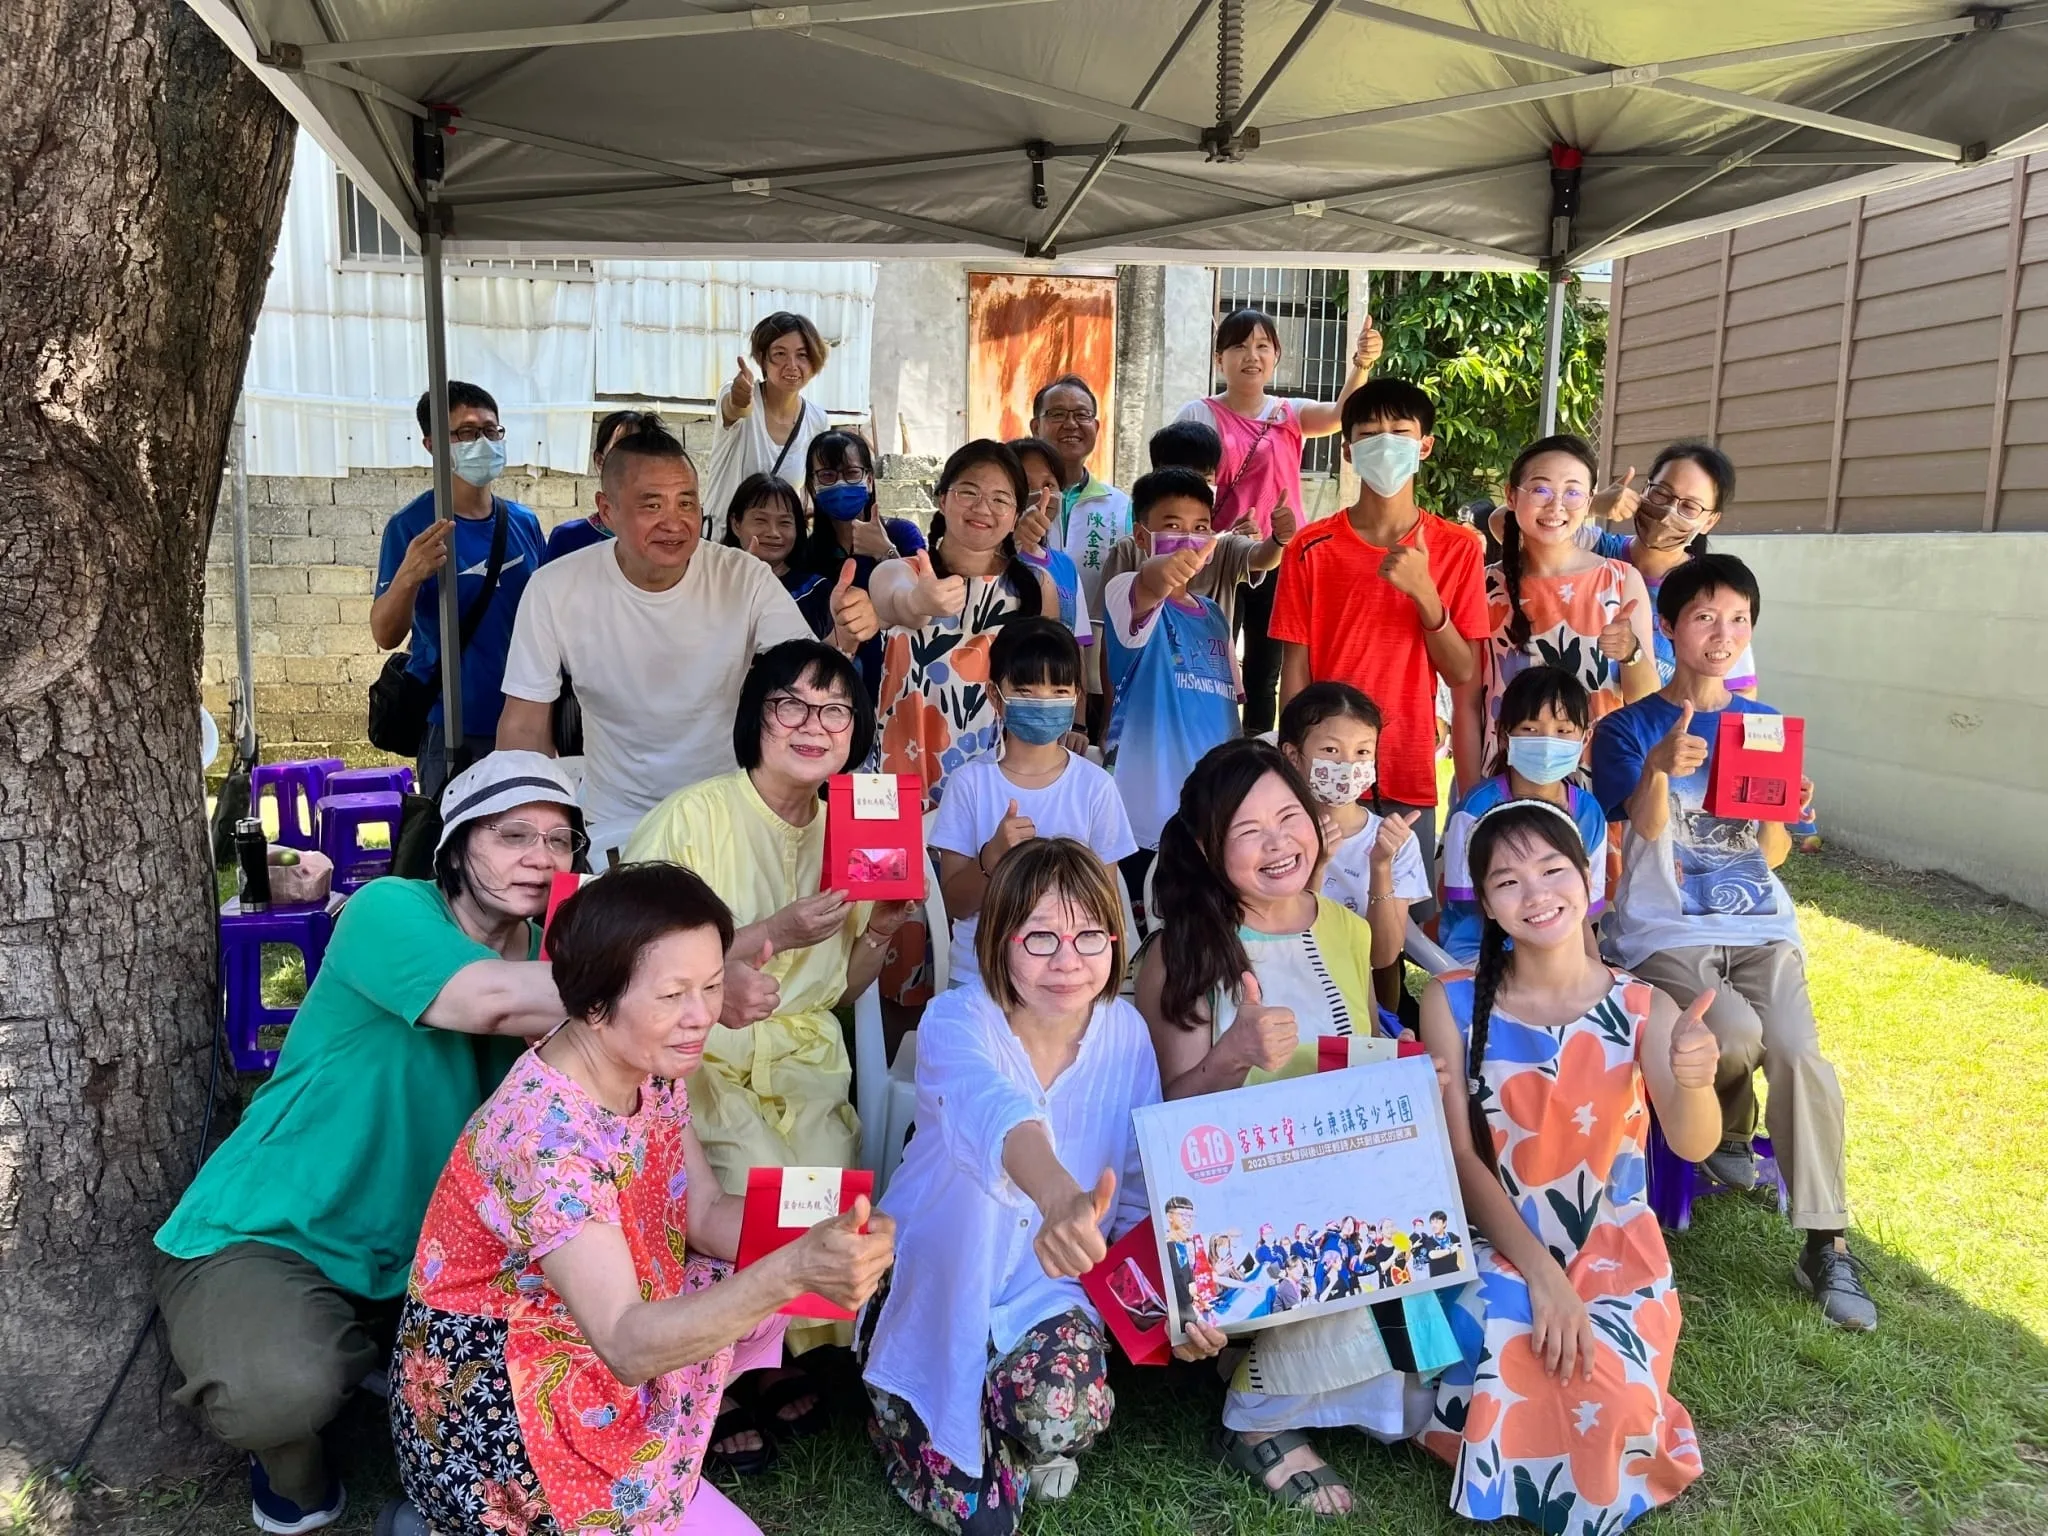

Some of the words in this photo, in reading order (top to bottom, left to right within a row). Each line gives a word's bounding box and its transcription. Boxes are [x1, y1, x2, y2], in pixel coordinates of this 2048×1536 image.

[1083, 512, 1106, 571] 陳金溪
[1186, 1130, 1227, 1169] 6.18
[1237, 1116, 1296, 1154] 客家女聲
[1312, 1095, 1414, 1138] 台東講客少年團
